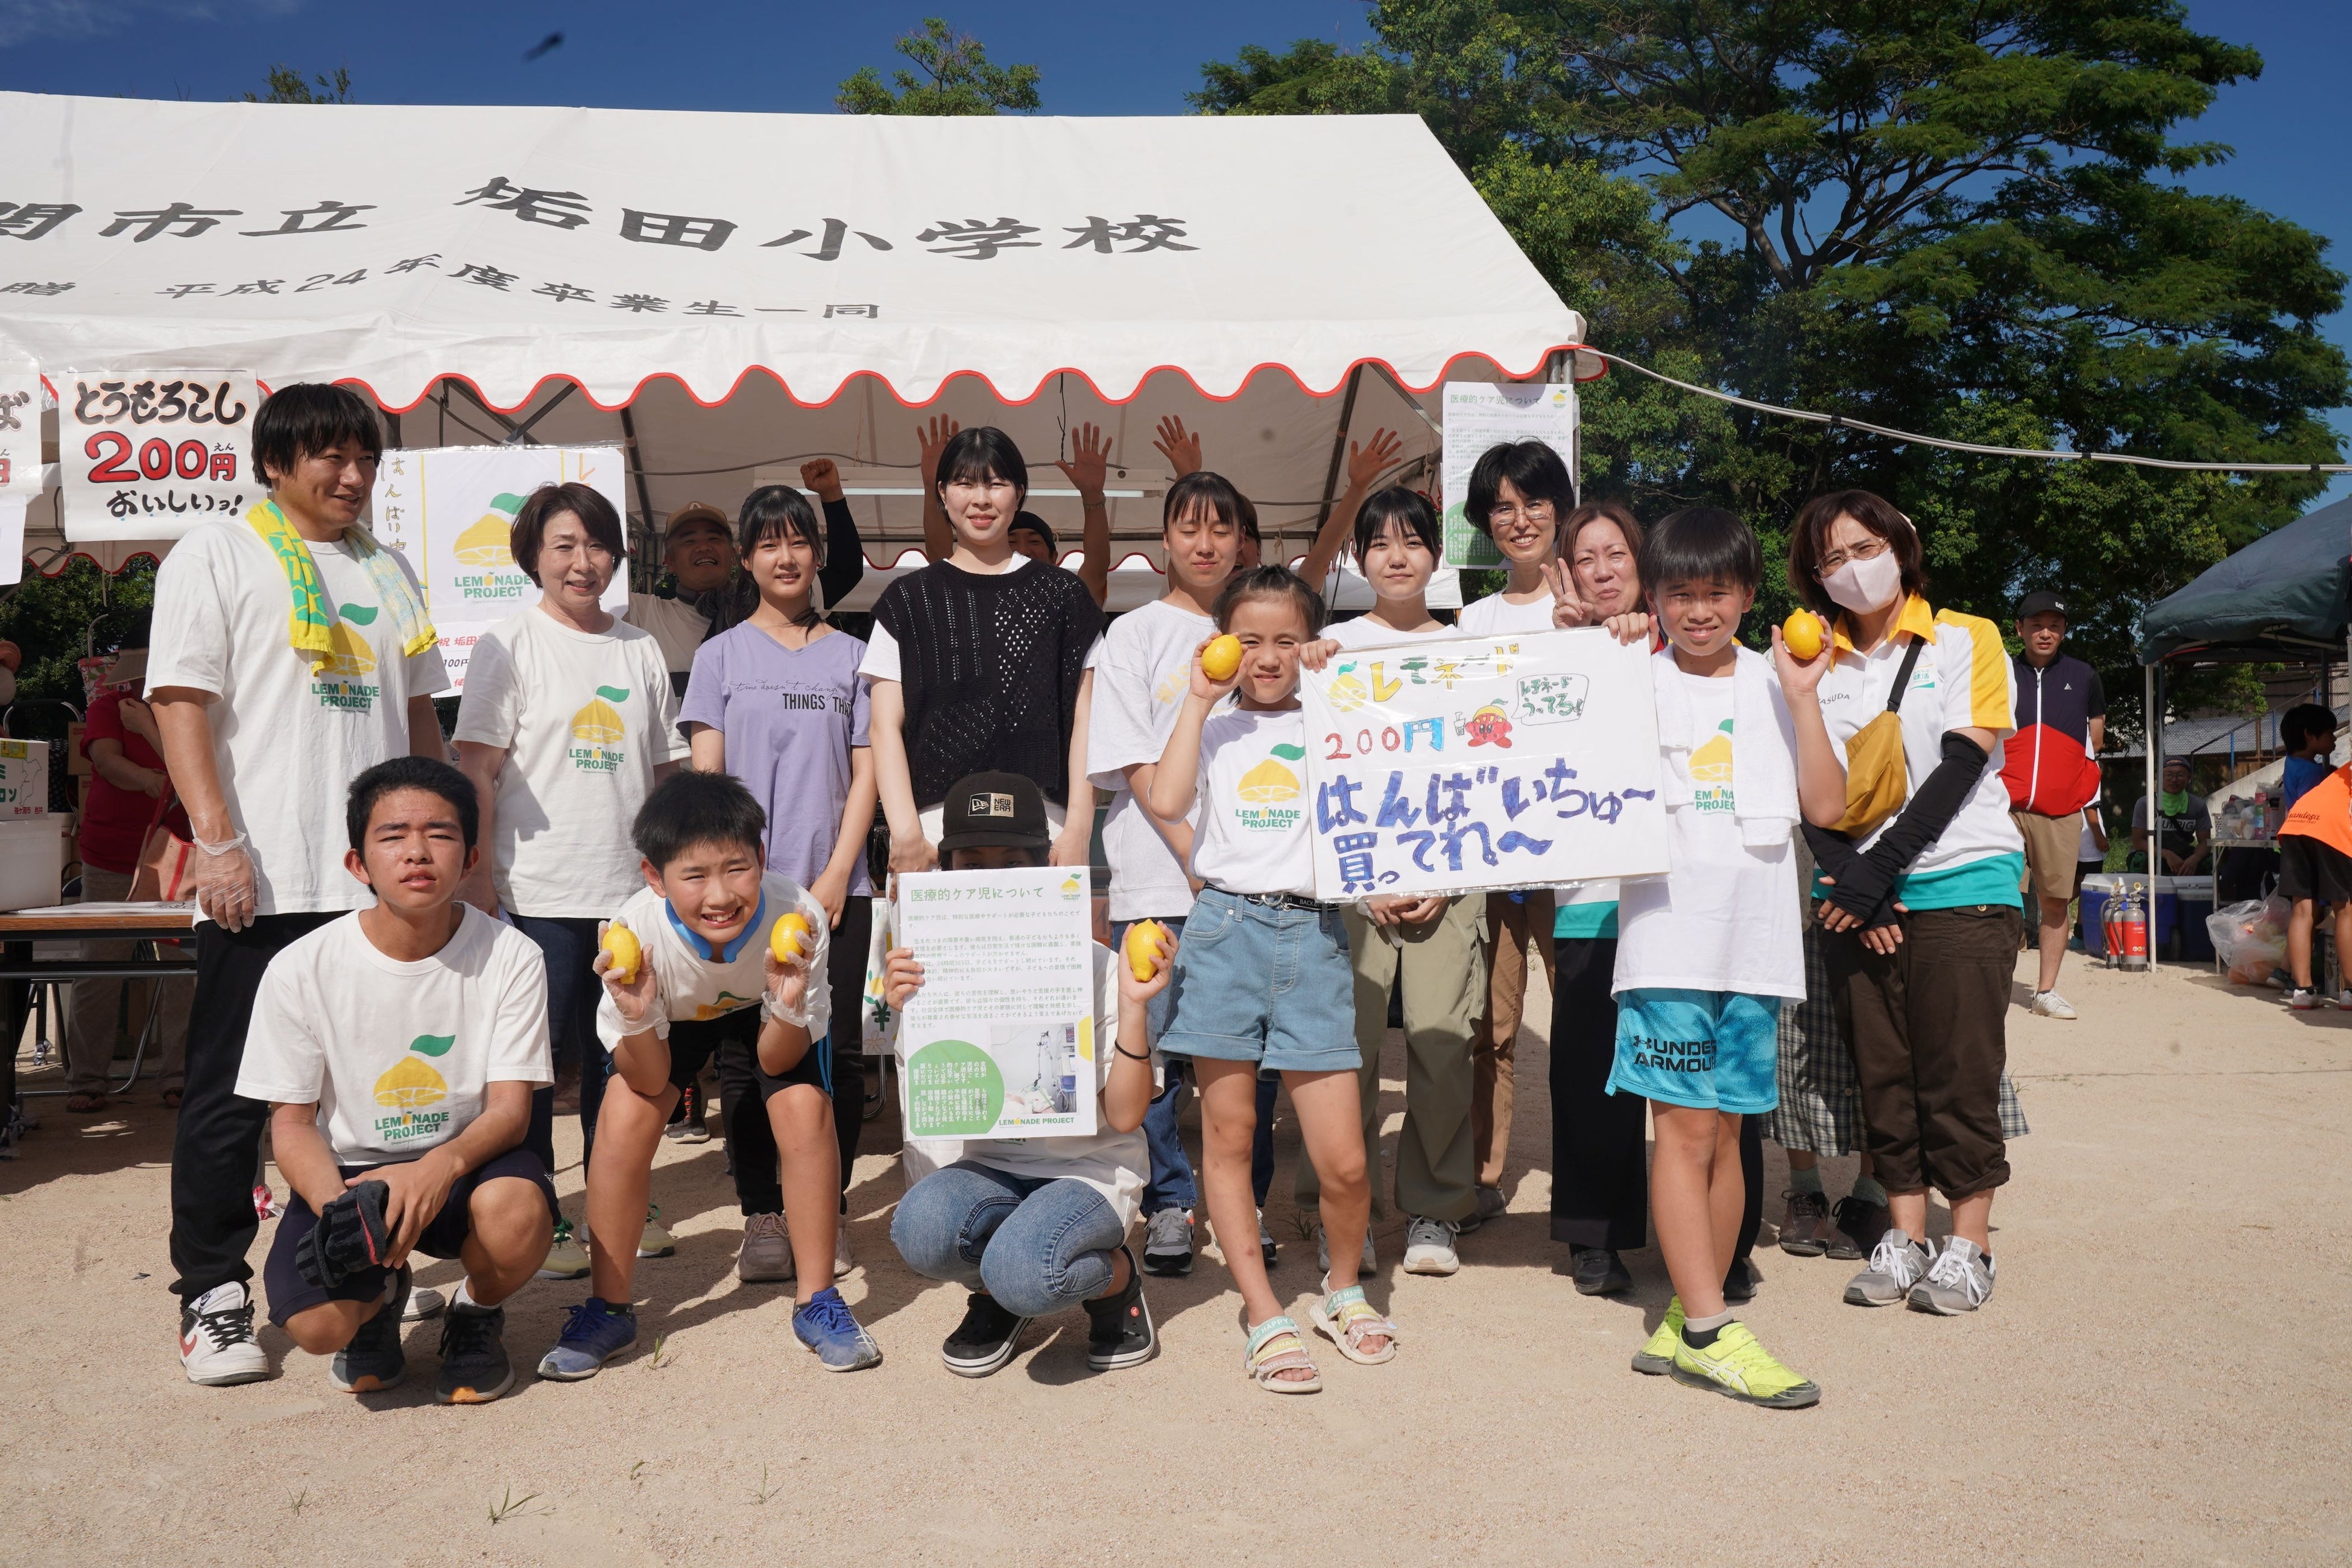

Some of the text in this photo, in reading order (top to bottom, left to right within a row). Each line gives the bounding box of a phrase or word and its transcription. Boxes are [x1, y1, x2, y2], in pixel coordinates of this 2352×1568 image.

[75, 381, 246, 425] とうもろこし
[84, 431, 237, 483] 200円
[464, 586, 523, 598] PROJECT
[454, 635, 481, 646] 垢田
[1371, 643, 1519, 702] レモネード
[321, 695, 373, 709] PROJECT
[783, 694, 826, 710] THINGS
[1325, 717, 1444, 760] 200円
[576, 759, 618, 771] PROJECT
[1242, 818, 1293, 828] PROJECT
[911, 887, 1043, 902] 医療的ケア児について
[384, 1123, 440, 1141] PROJECT
[1261, 1318, 1289, 1334] HAPPY
